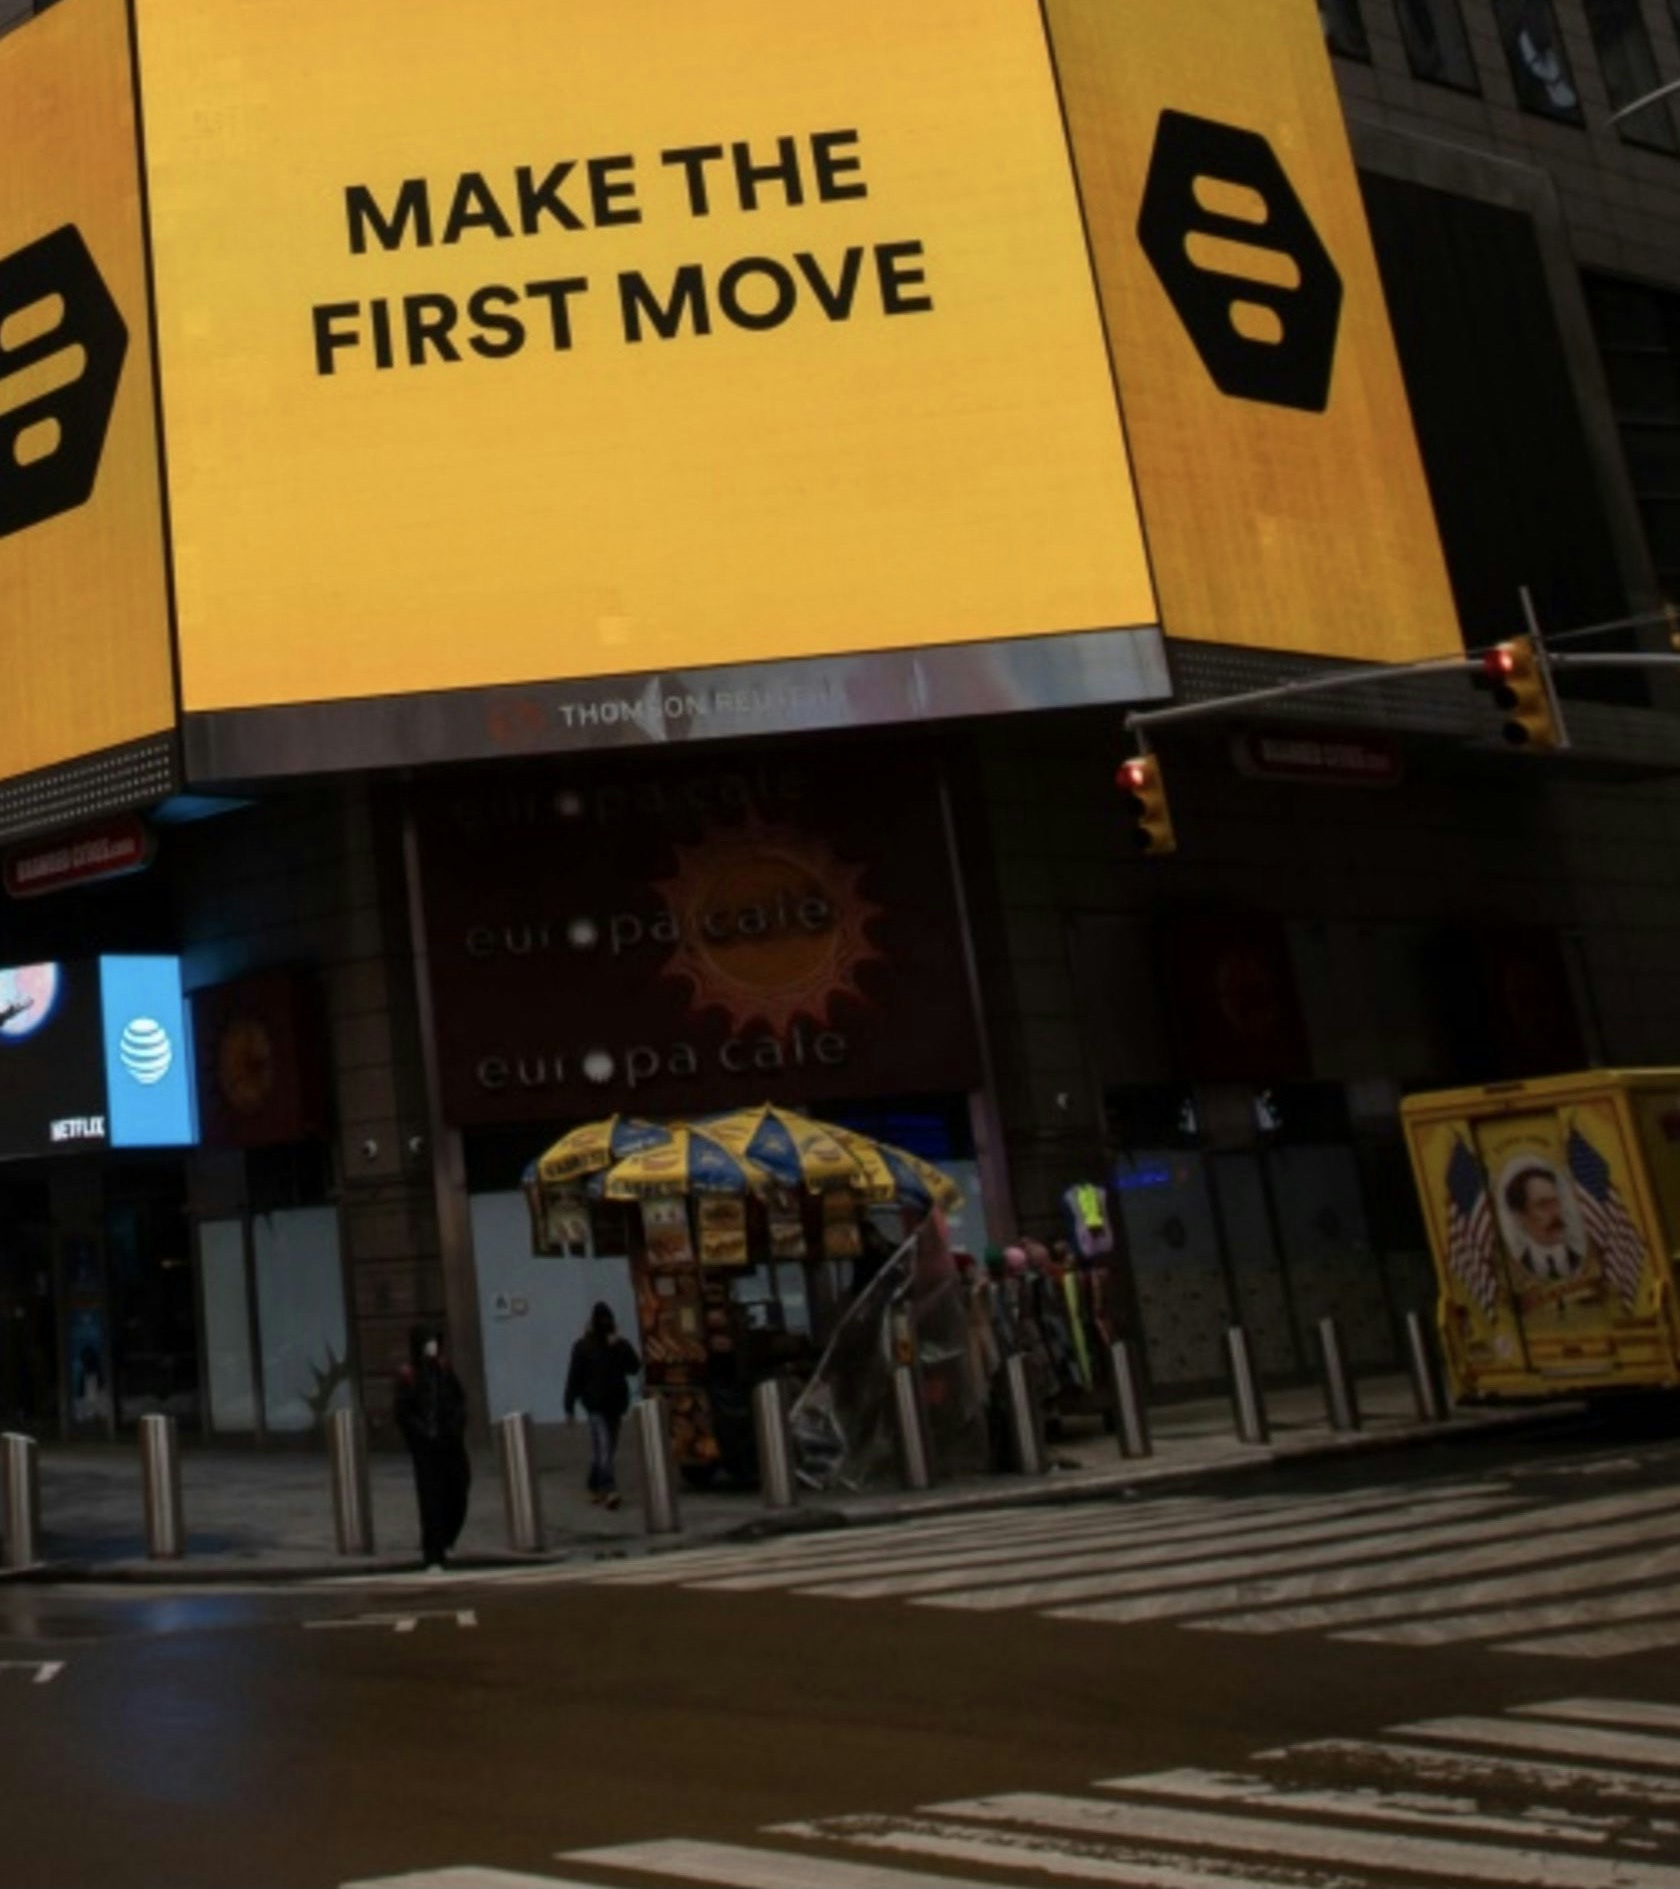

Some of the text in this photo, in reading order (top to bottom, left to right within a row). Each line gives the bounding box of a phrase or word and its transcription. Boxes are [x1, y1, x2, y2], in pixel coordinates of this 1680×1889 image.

[345, 129, 868, 255] MAKE THE
[312, 239, 934, 376] FIRST MOVE
[464, 908, 680, 957] europa
[475, 1039, 700, 1090] europa
[49, 1115, 106, 1143] NETFLIX
